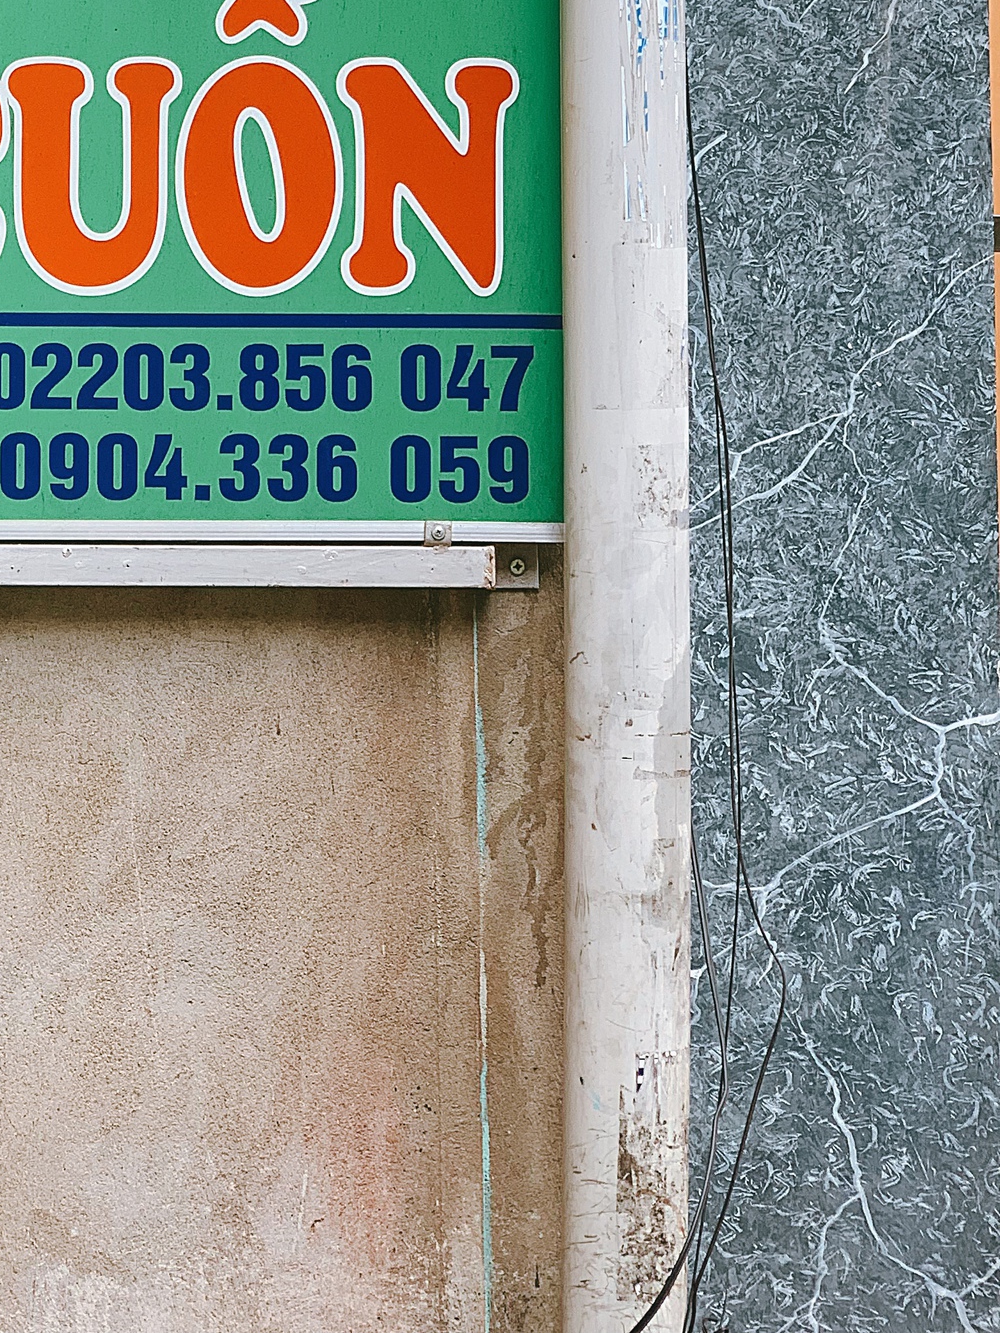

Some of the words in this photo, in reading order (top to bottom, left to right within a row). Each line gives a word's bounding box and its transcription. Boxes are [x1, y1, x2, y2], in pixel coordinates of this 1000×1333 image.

[400, 344, 534, 412] 047
[0, 432, 358, 502] 0904.336
[390, 435, 529, 503] 059
